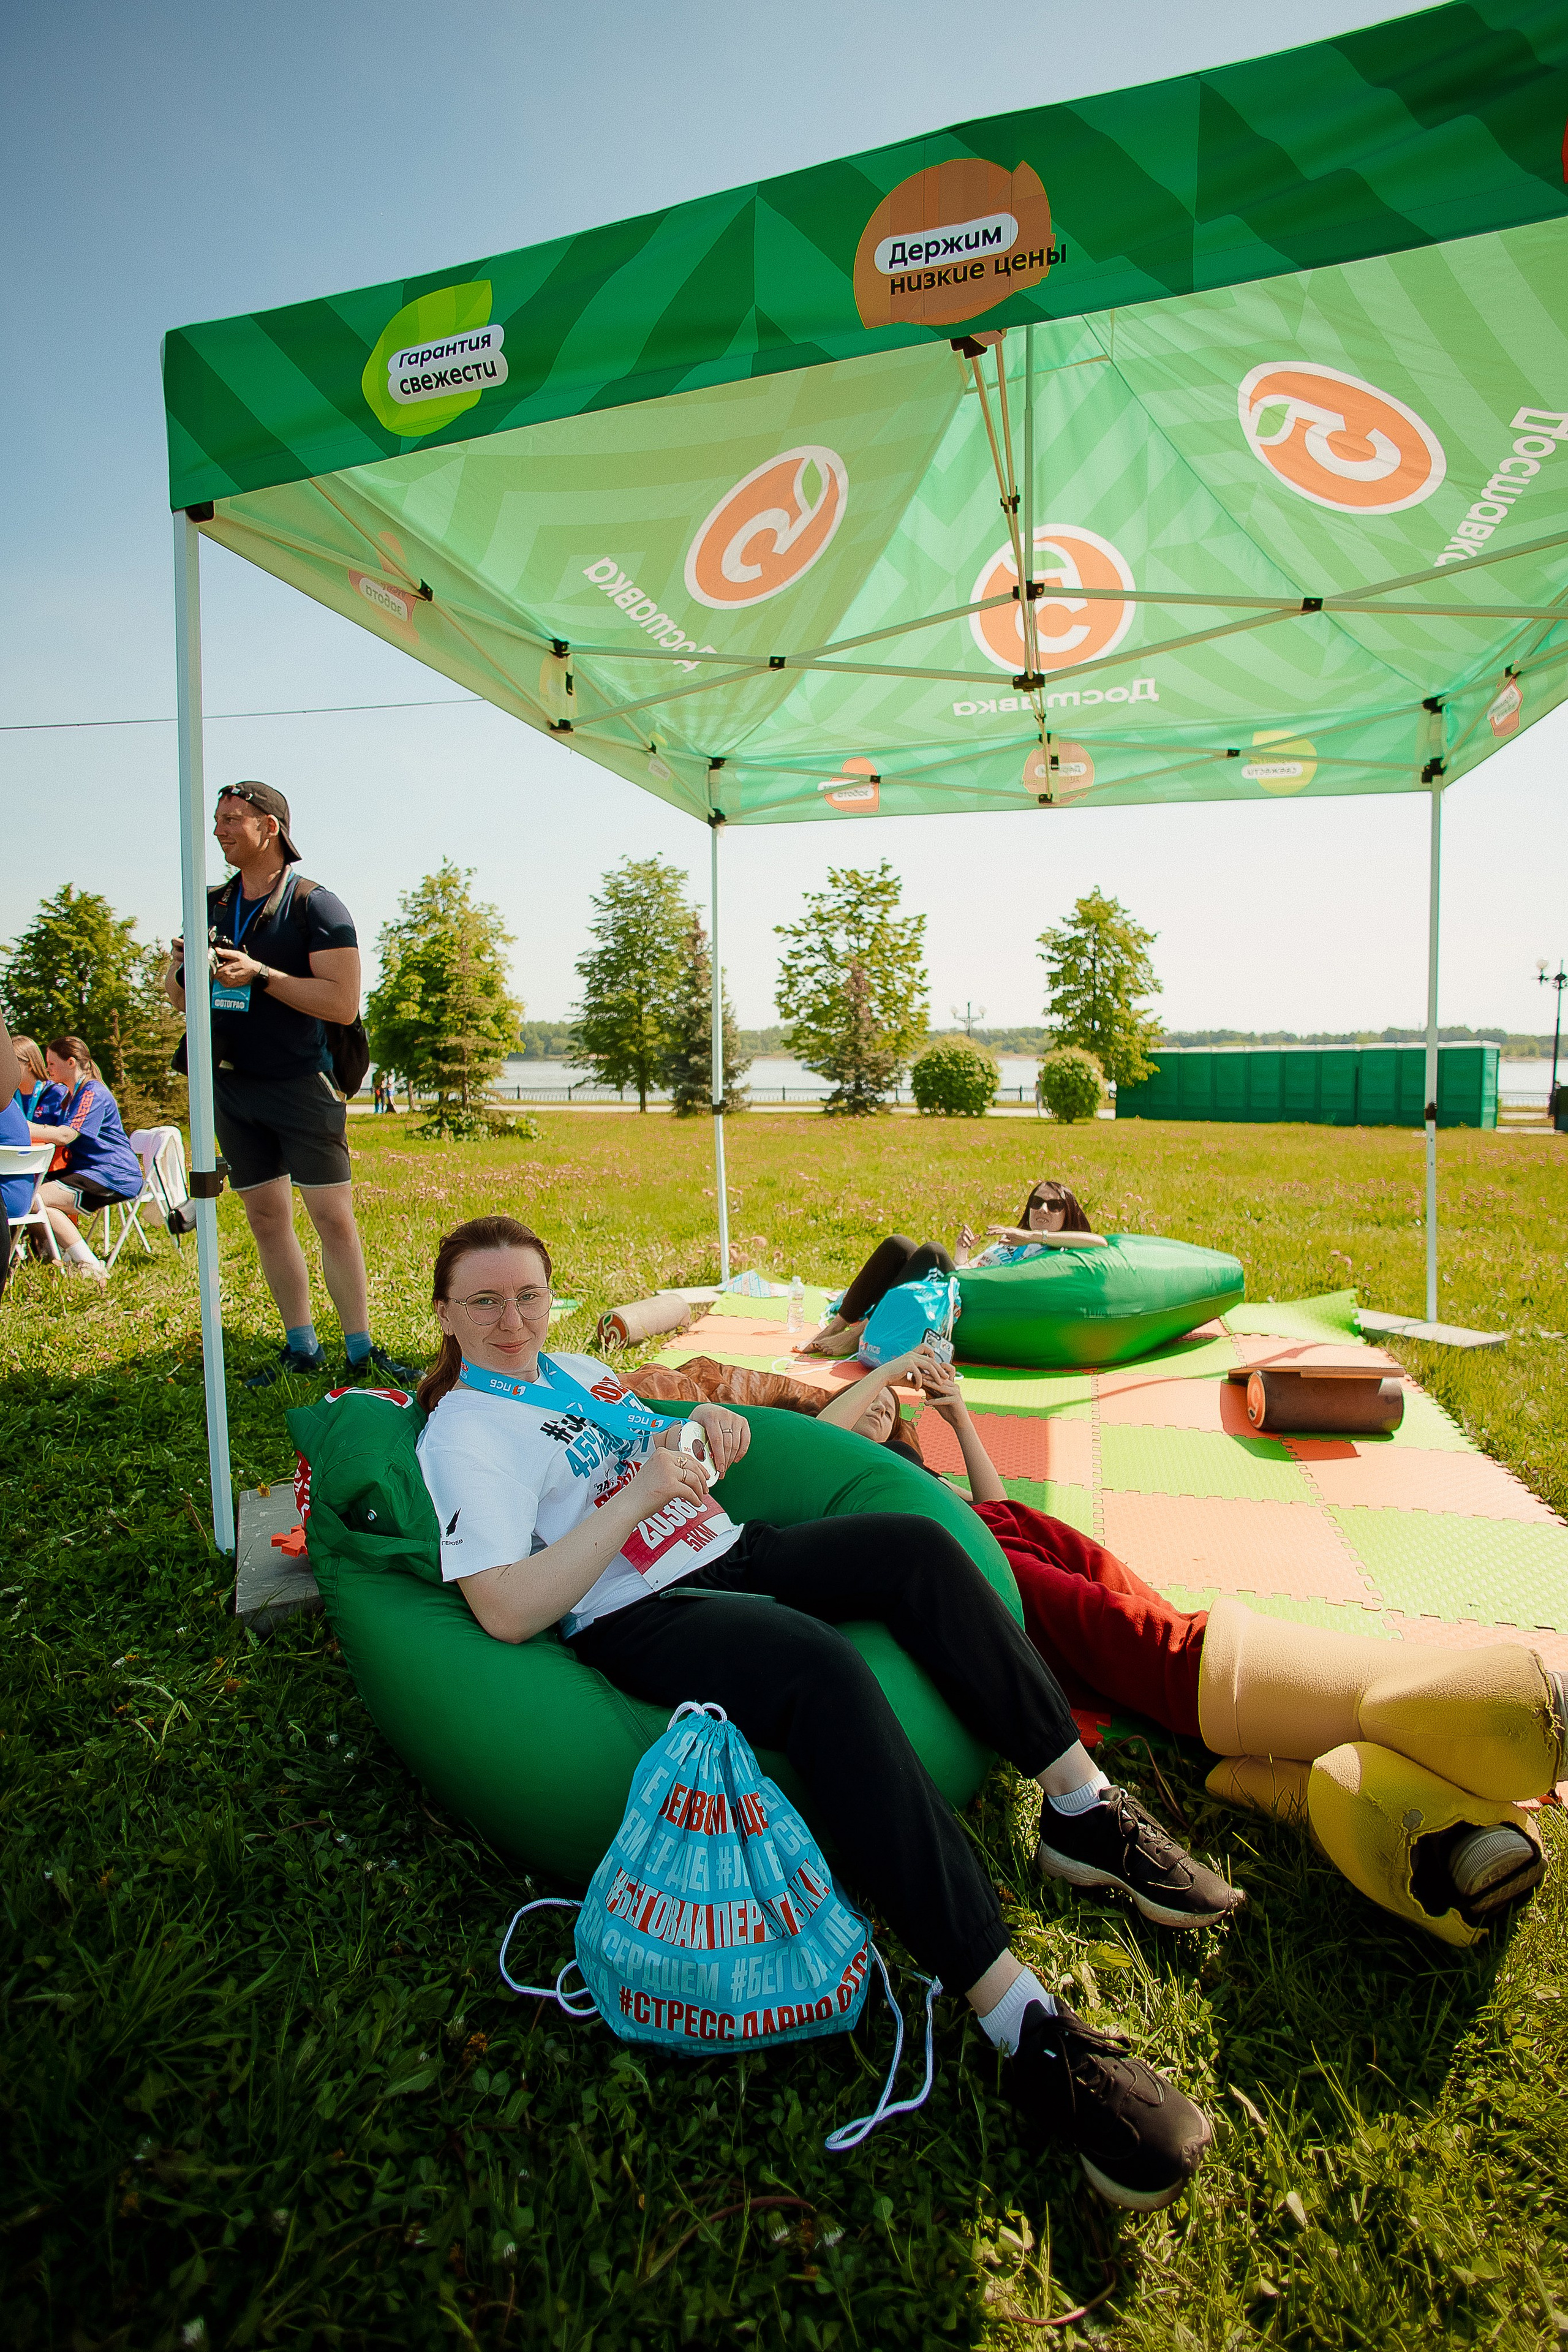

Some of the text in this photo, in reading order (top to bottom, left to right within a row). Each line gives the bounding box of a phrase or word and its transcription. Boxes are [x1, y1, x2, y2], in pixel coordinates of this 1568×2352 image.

[888, 225, 1002, 269] Держим
[890, 244, 1066, 295] низкие цены
[398, 333, 491, 368] Гарантия
[399, 360, 498, 396] свежести
[601, 1929, 719, 2002] СЕРДЦЕМ
[619, 1985, 736, 2041] #СТРЕСС
